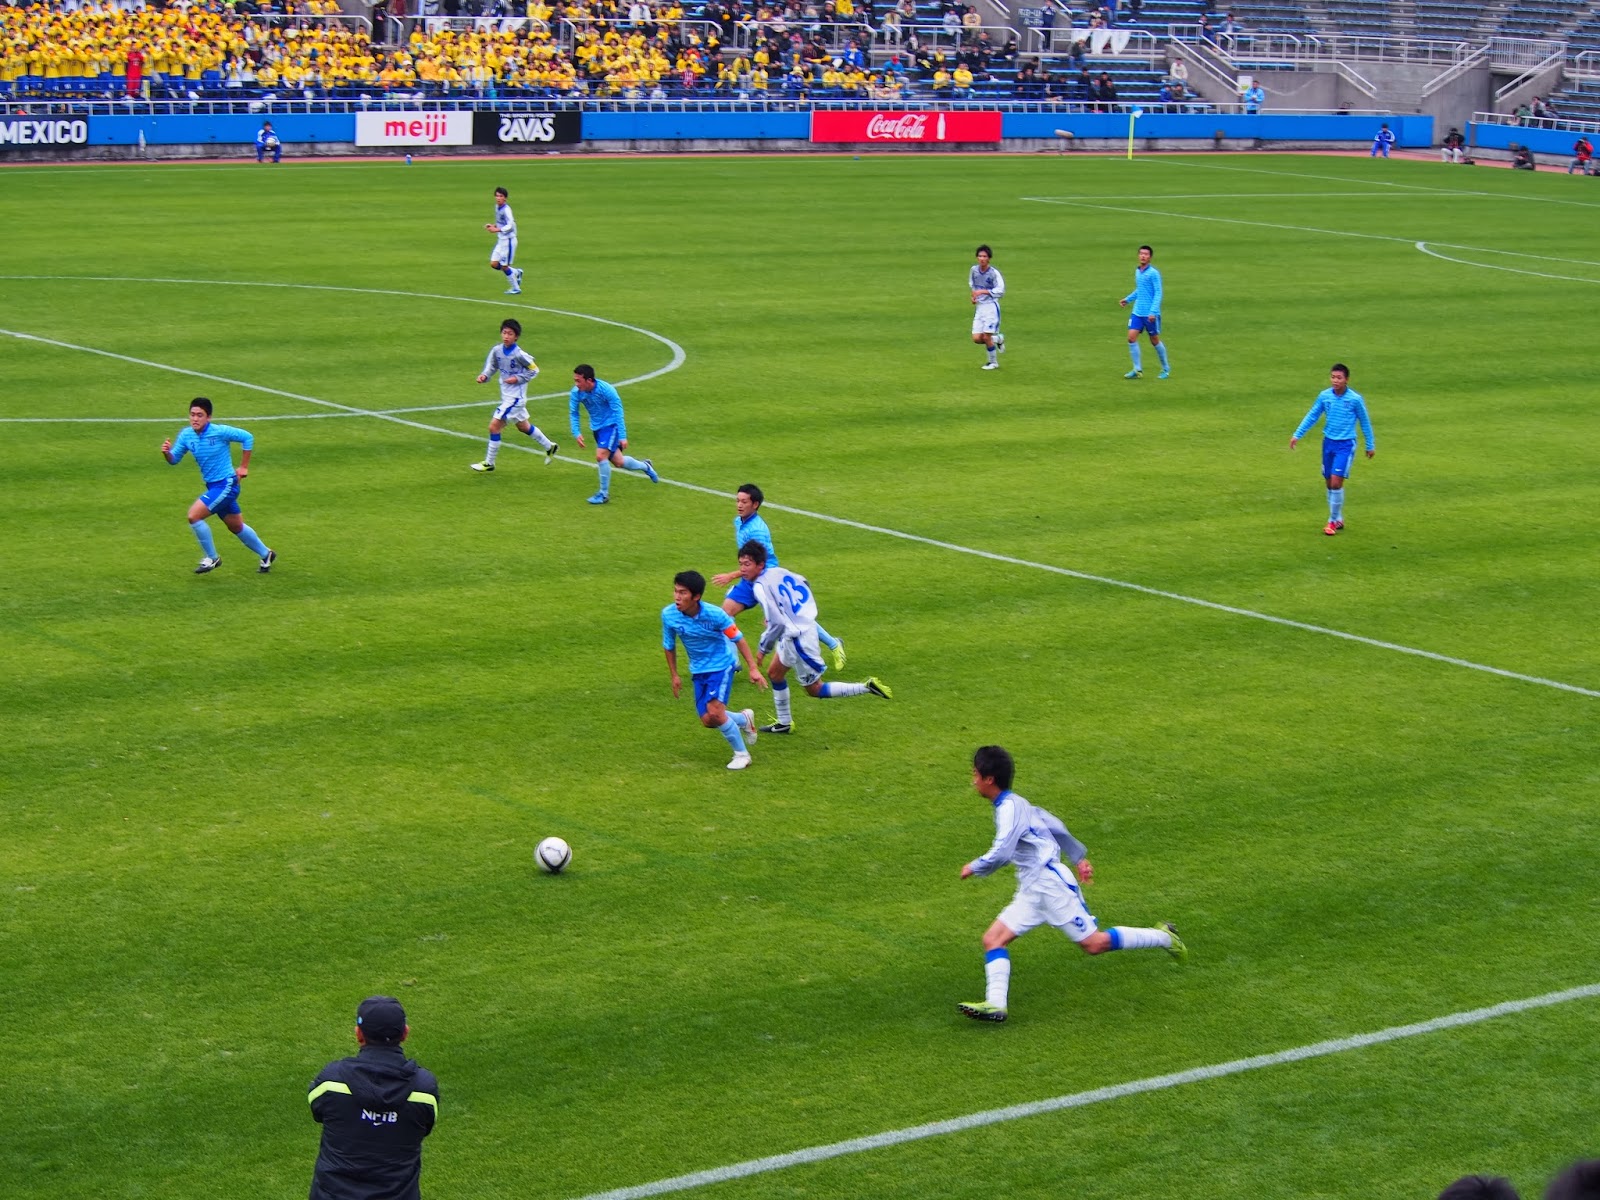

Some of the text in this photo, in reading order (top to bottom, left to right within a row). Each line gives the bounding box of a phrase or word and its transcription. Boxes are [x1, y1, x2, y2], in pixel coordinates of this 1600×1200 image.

[0, 120, 88, 144] MEXICO
[385, 114, 446, 142] meiji
[778, 575, 809, 615] 23
